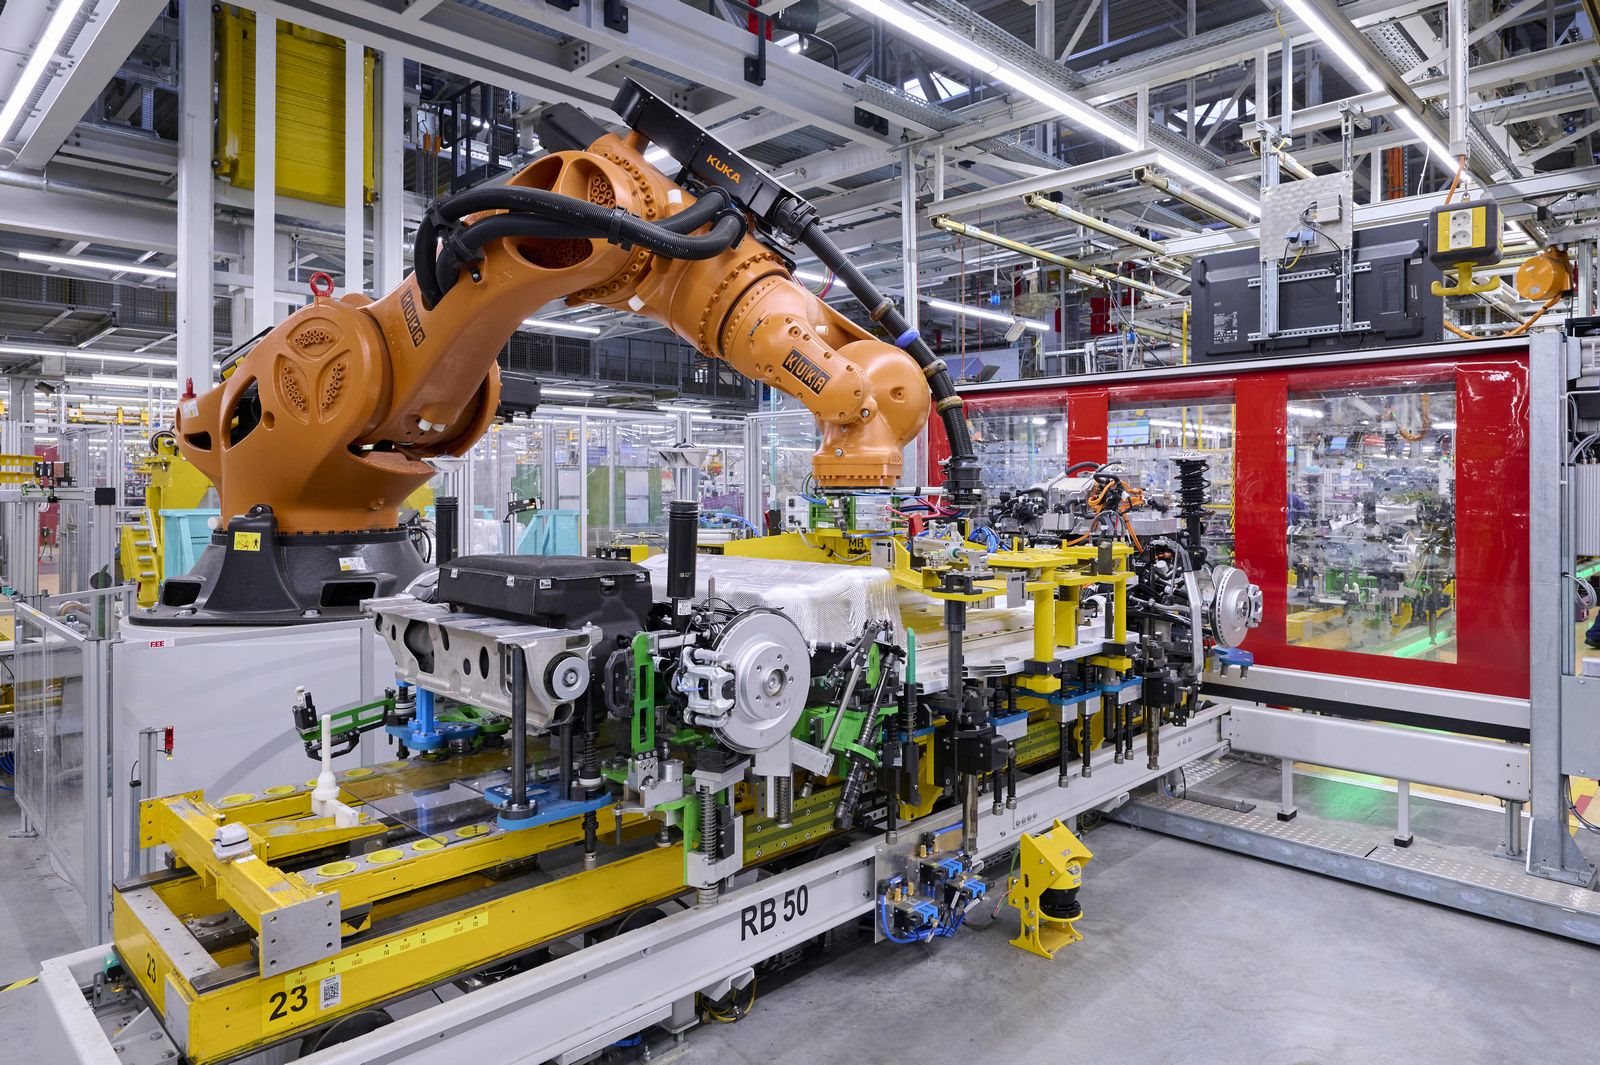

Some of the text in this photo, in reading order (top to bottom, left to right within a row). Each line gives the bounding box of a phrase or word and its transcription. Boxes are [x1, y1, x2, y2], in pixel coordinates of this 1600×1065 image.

[706, 154, 741, 184] KUKA
[402, 290, 424, 345] KUKA
[785, 353, 827, 391] KUKA
[741, 884, 809, 941] RB 50
[146, 951, 157, 984] 23
[269, 984, 308, 1022] 23
